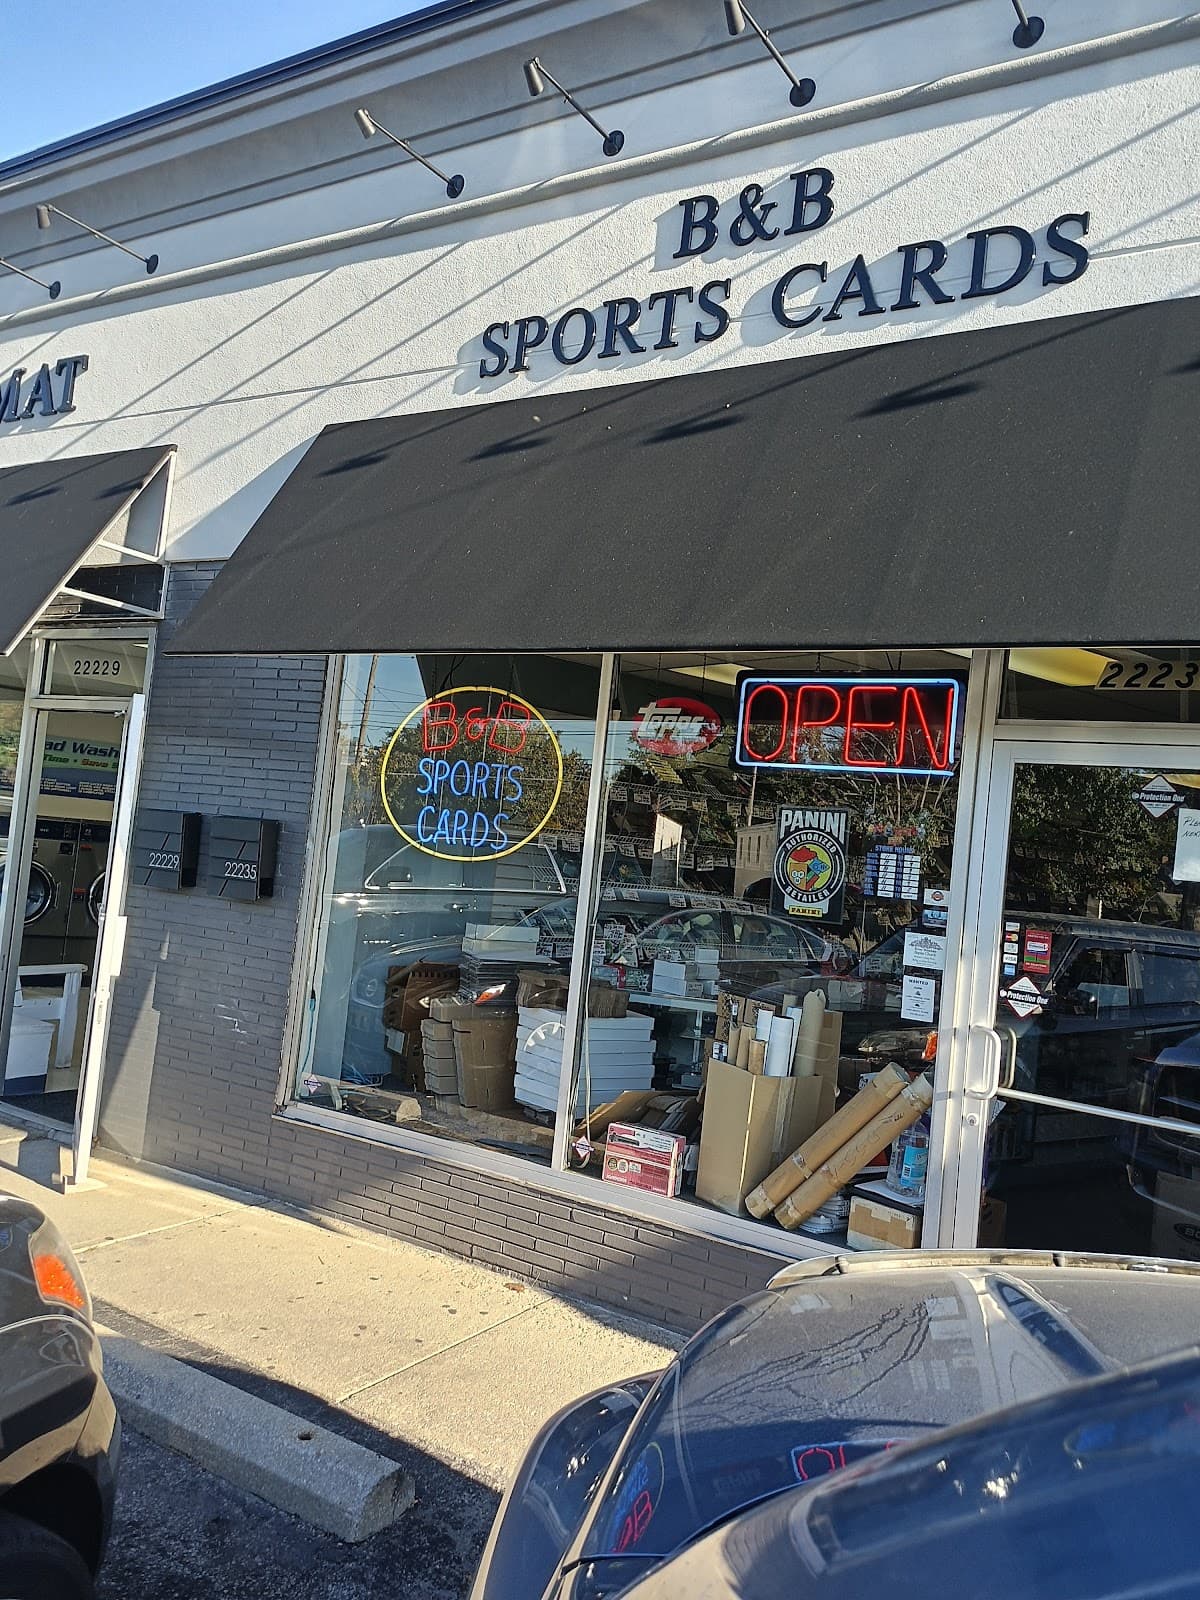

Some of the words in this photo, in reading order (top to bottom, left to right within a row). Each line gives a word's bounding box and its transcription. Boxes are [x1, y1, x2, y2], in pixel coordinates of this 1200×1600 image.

[673, 167, 834, 258] B&B
[479, 278, 731, 378] SPORTS
[771, 210, 1090, 328] CARDS
[74, 660, 120, 676] 22229
[1099, 662, 1199, 688] 2223
[743, 684, 955, 769] OPEN
[416, 757, 524, 803] SPORTS
[1139, 792, 1172, 801] Protection
[416, 805, 509, 851] CARDS
[780, 809, 847, 845] PANINI
[785, 832, 837, 854] AUTHORIZED
[149, 852, 180, 869] 22229
[224, 862, 257, 880] 22235
[785, 887, 831, 903] RETAILER
[790, 906, 821, 916] PANINI
[1006, 990, 1036, 1003] Protection
[1036, 996, 1049, 1004] One
